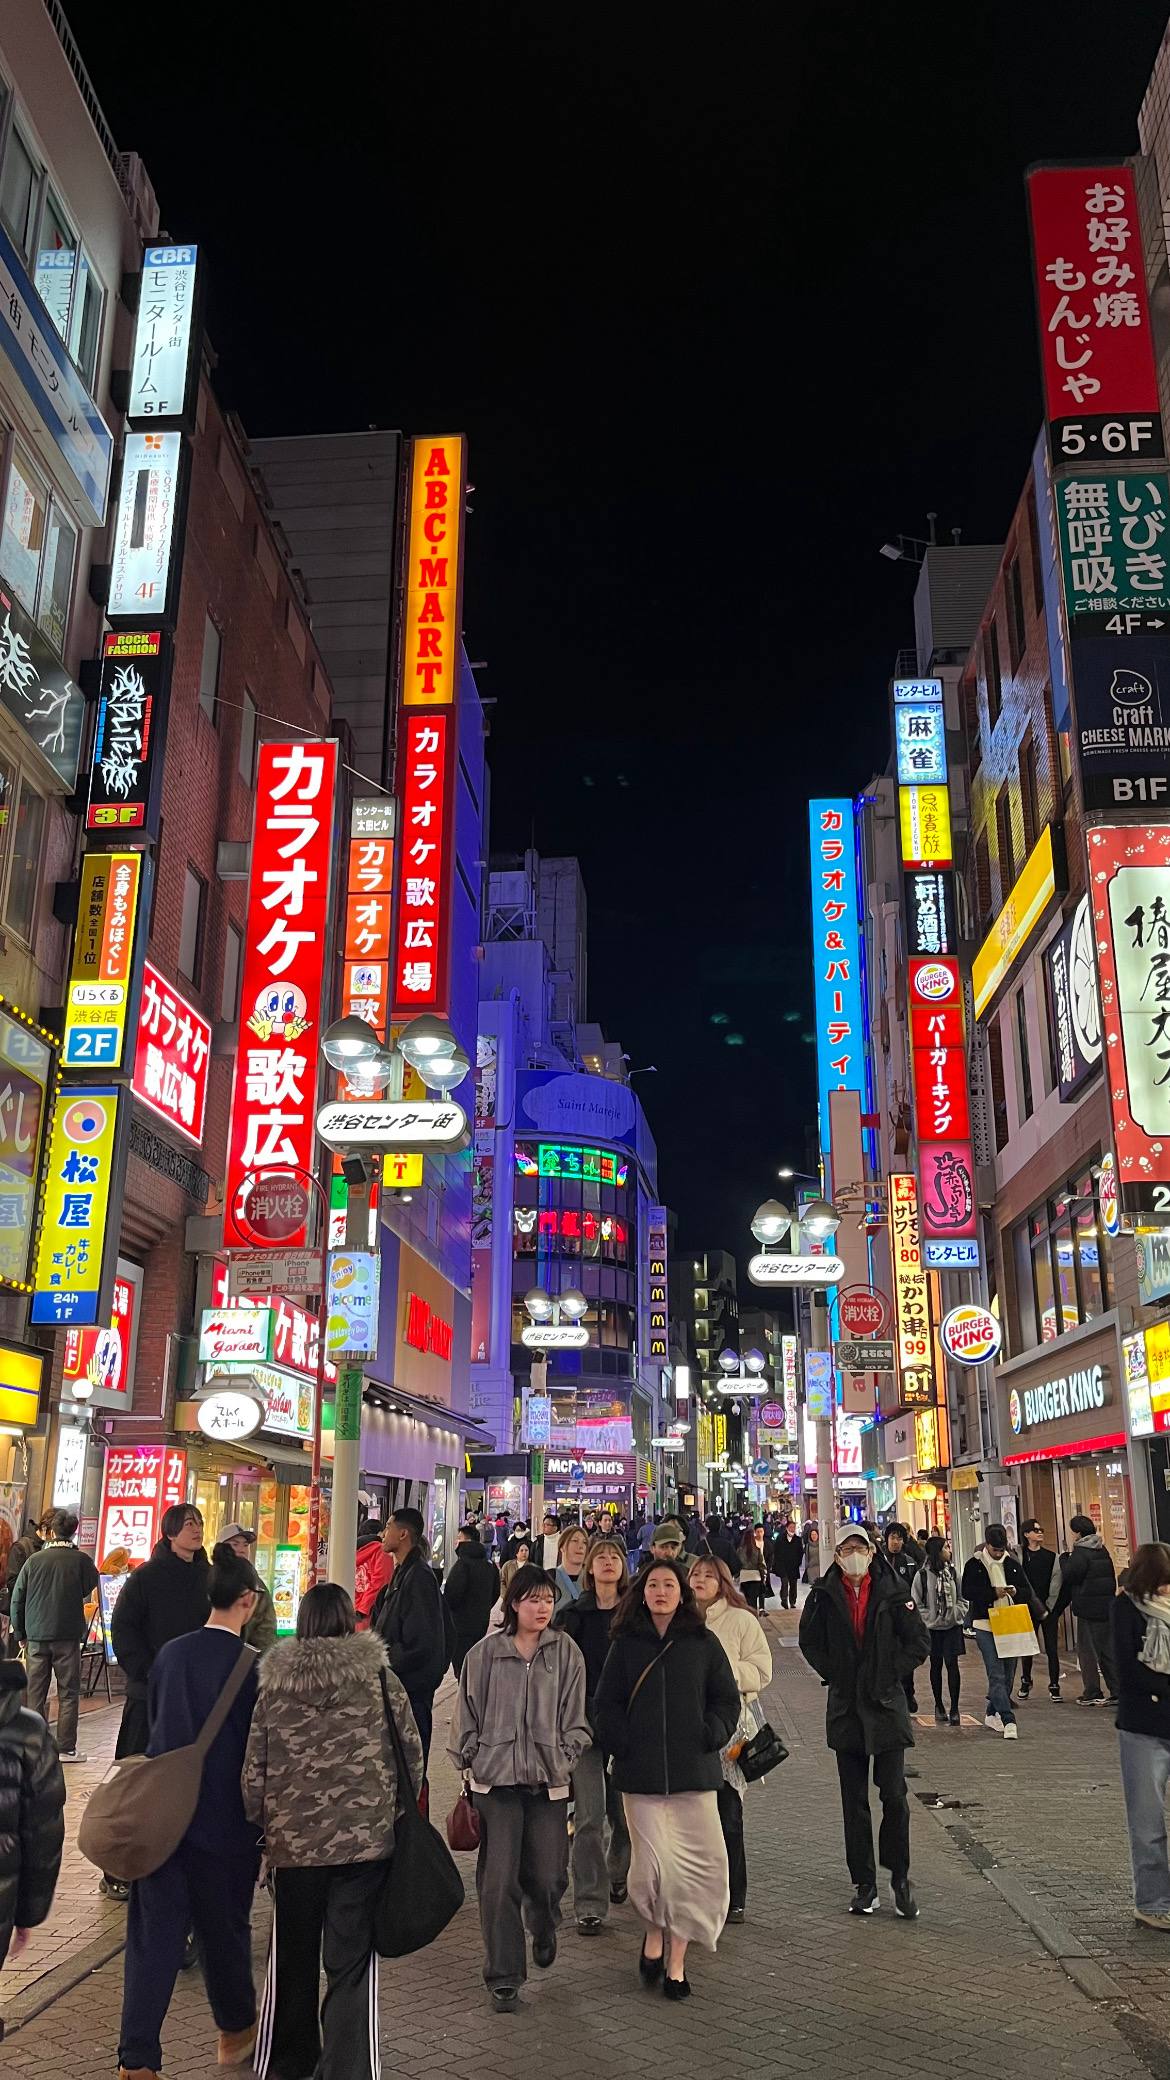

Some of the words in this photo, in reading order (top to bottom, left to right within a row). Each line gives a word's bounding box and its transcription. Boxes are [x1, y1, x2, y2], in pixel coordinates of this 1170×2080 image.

[149, 248, 191, 264] CBR
[1085, 182, 1141, 328] お好み焼
[168, 269, 189, 348] 渋谷センター街
[137, 271, 170, 394] モニタールーム
[1045, 257, 1101, 403] もんじゃ
[143, 401, 169, 414] 5F
[1064, 481, 1118, 594] 無呼吸
[1117, 480, 1167, 591] いびき
[416, 448, 451, 694] ABC-MART
[134, 582, 162, 599] 4F
[1074, 596, 1170, 612] ご相談ください
[1105, 614, 1140, 635] 4F
[107, 644, 157, 656] FASHION
[117, 634, 150, 646] ROCK
[896, 685, 940, 698] センタービル
[1115, 681, 1146, 695] craft
[928, 705, 942, 714] 5F
[1112, 706, 1153, 725] Craft
[907, 715, 934, 769] 麻雀
[1082, 728, 1126, 745] CHEESE
[1113, 777, 1168, 802] B1F
[94, 808, 138, 825] 3F
[355, 806, 392, 816] センター街
[921, 792, 942, 854] 鳥貴族
[256, 746, 326, 975] カラオケ
[921, 860, 934, 868] 4F
[355, 841, 394, 954] カラオケ
[83, 876, 106, 965] 店舗数全国1位
[106, 865, 132, 976] 全身もみほぐし
[914, 875, 940, 954] 一軒め酒場
[820, 809, 852, 1093] カラオケ&パーティ
[919, 970, 948, 984] BURGER
[920, 978, 950, 994] KING
[77, 988, 120, 1001] りらくる
[73, 1009, 118, 1024] 渋谷店
[140, 979, 208, 1074] カラオケ
[75, 1033, 112, 1057] 2F
[145, 1043, 197, 1127] 歌広場
[927, 1014, 952, 1135] バーガーキング
[557, 1098, 586, 1111] Saint
[323, 1113, 457, 1130] 渋谷センター街
[239, 1047, 308, 1222] 歌広
[57, 1151, 99, 1227] 松屋
[256, 1184, 270, 1193] FIRE
[271, 1184, 300, 1192] HYDRANT
[251, 1193, 305, 1220] 消火栓
[895, 1205, 908, 1247] サワー
[65, 1244, 77, 1281] カレー
[77, 1239, 91, 1275] 牛めし
[927, 1246, 977, 1259] センタービル
[50, 1252, 64, 1286] 定食
[756, 1263, 841, 1274] 渋谷センター街
[898, 1274, 925, 1285] 秘伝
[53, 1293, 79, 1304] 24h
[55, 1308, 73, 1319] 1F
[844, 1305, 880, 1322] 消火栓
[901, 1286, 926, 1337] かわ串
[203, 1323, 254, 1336] Miami
[948, 1317, 991, 1338] BURGER
[950, 1326, 994, 1352] KING
[860, 1349, 892, 1358] 宝石広場
[904, 1371, 930, 1392] B1
[1023, 1378, 1070, 1426] BURGER
[1068, 1364, 1104, 1414] KING
[109, 1454, 160, 1475] カラオケ
[107, 1478, 158, 1498] 歌広場
[112, 1509, 150, 1529] 入口
[107, 1530, 148, 1547] こちら
